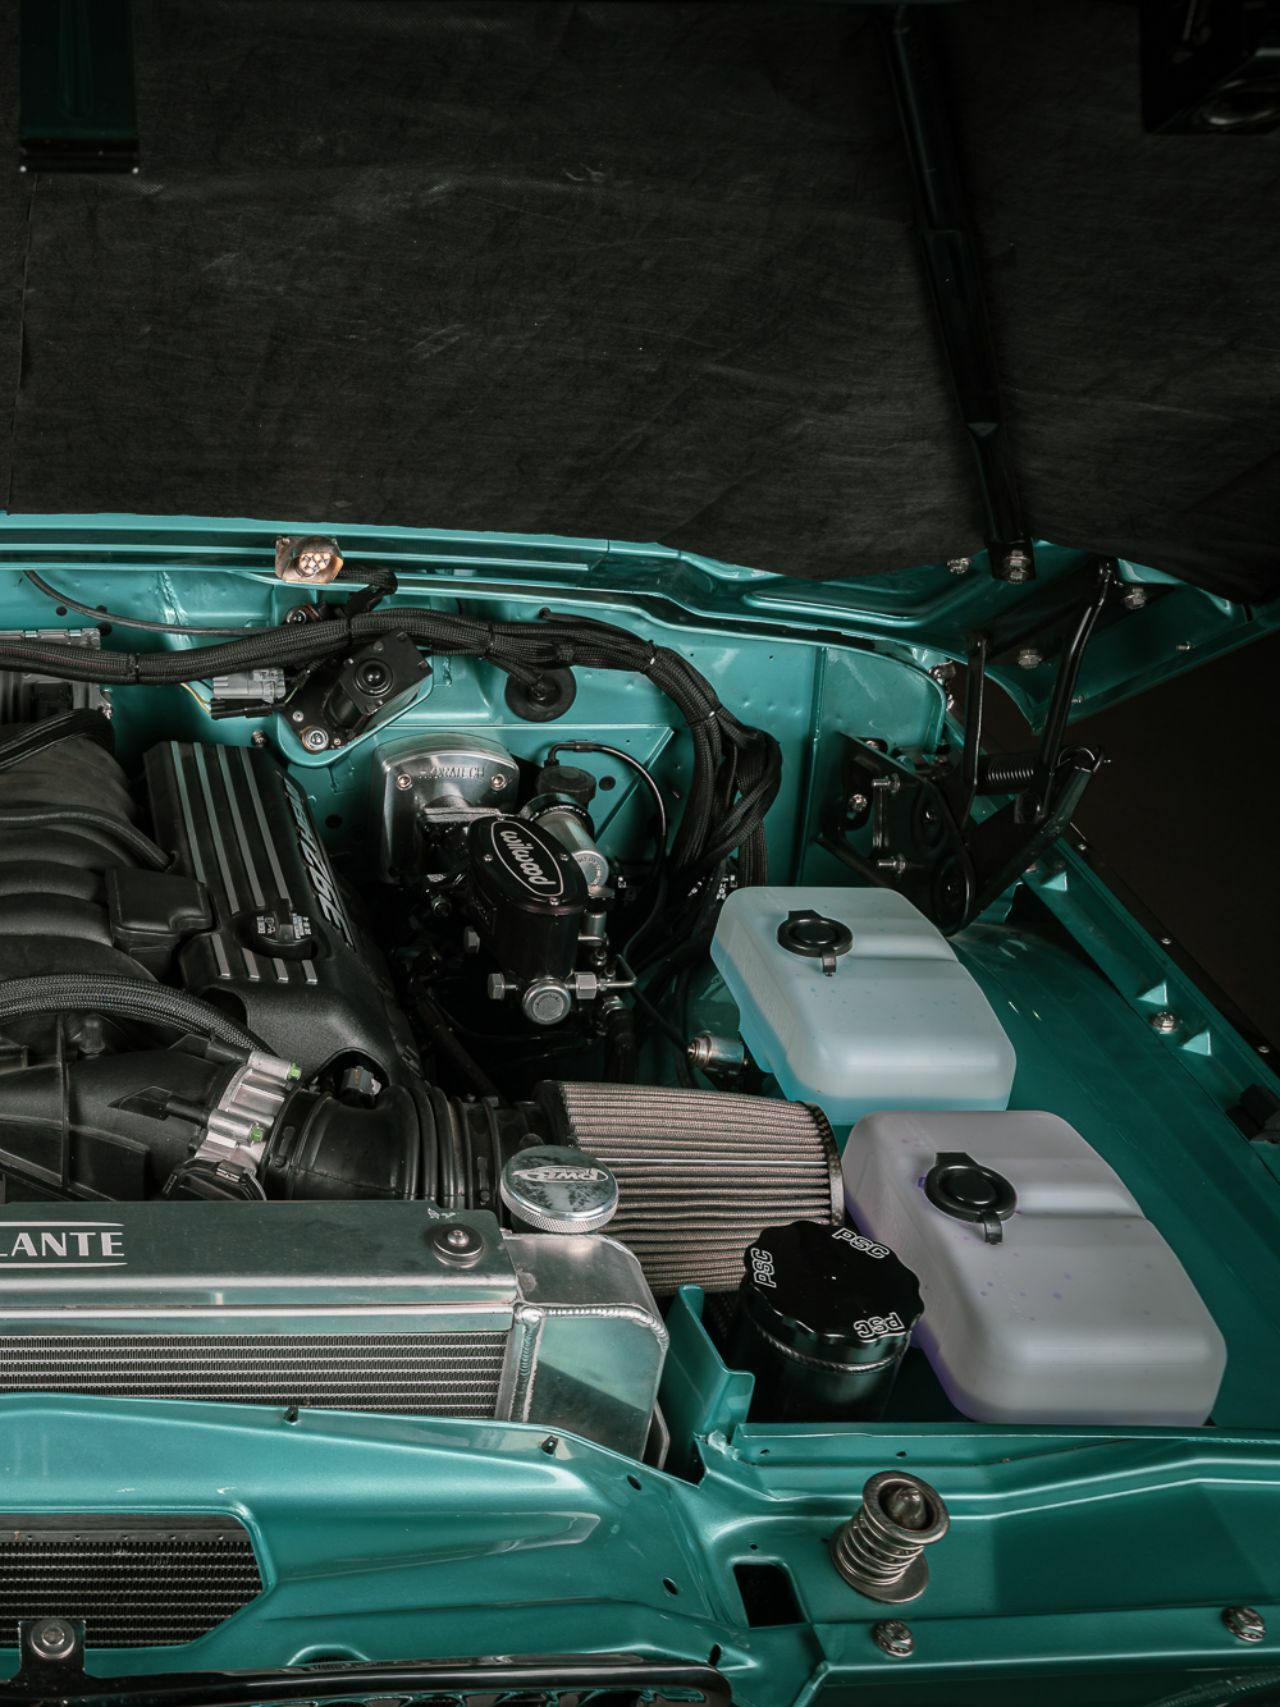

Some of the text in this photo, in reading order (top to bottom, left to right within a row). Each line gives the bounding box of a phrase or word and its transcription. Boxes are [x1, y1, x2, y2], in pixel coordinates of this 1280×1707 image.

[500, 830, 557, 885] wilwood
[300, 838, 355, 950] 392
[831, 1227, 890, 1259] PSC
[750, 1247, 777, 1288] PSC
[853, 1312, 905, 1338] PSC
